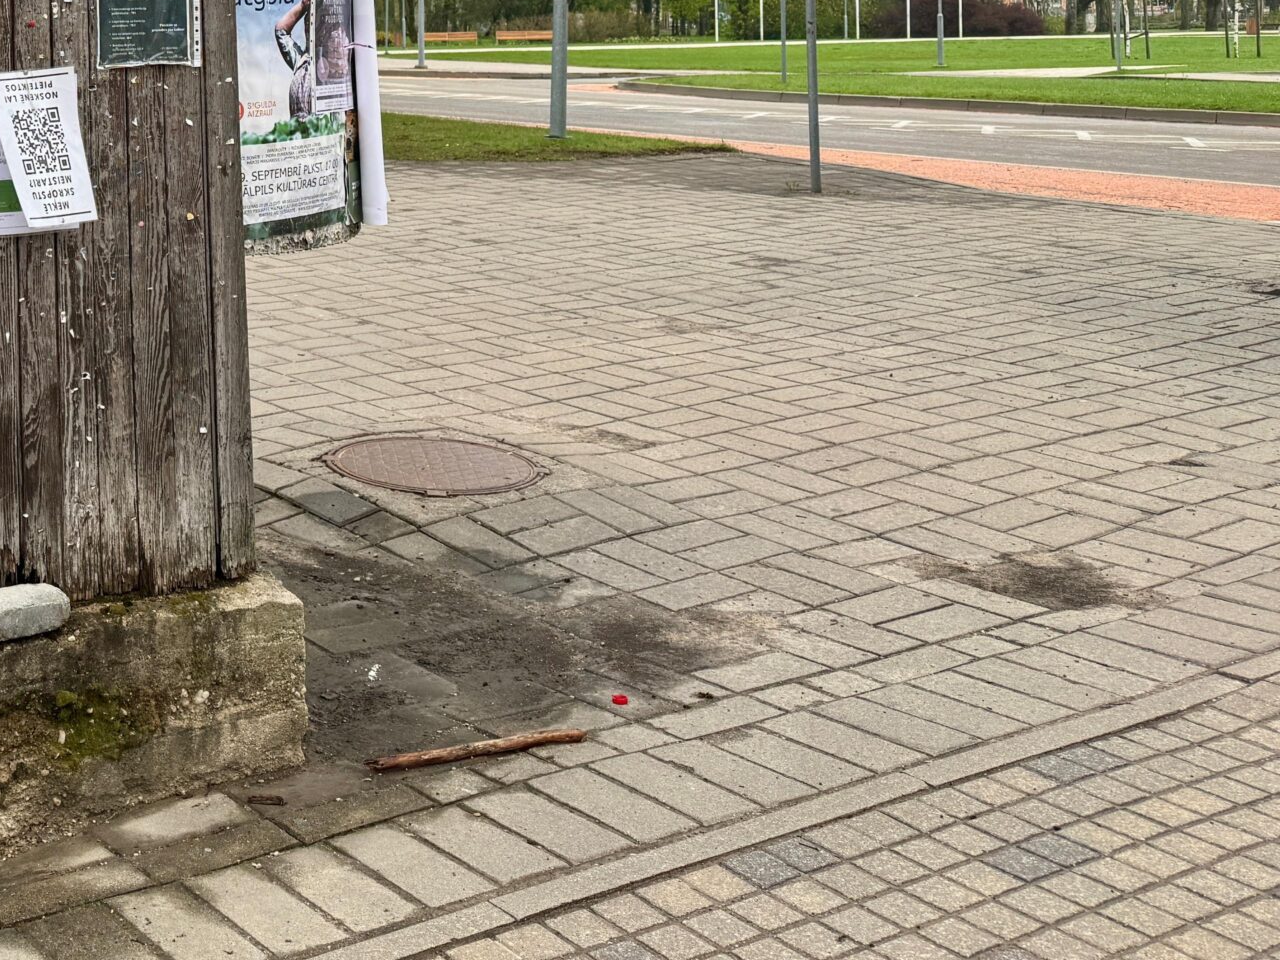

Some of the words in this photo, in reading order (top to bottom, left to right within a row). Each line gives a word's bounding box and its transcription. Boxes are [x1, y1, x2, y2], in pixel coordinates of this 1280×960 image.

[5, 81, 52, 92] PIETEIKTOS
[4, 95, 17, 103] LAI
[252, 164, 301, 182] SEPTEMBRĪ
[30, 175, 72, 187] MEISTARI?
[242, 184, 274, 196] ĀLPILS
[277, 178, 316, 192] KULTŪRAS
[32, 188, 74, 200] SKROPSTU
[44, 201, 70, 214] MEKLĒ
